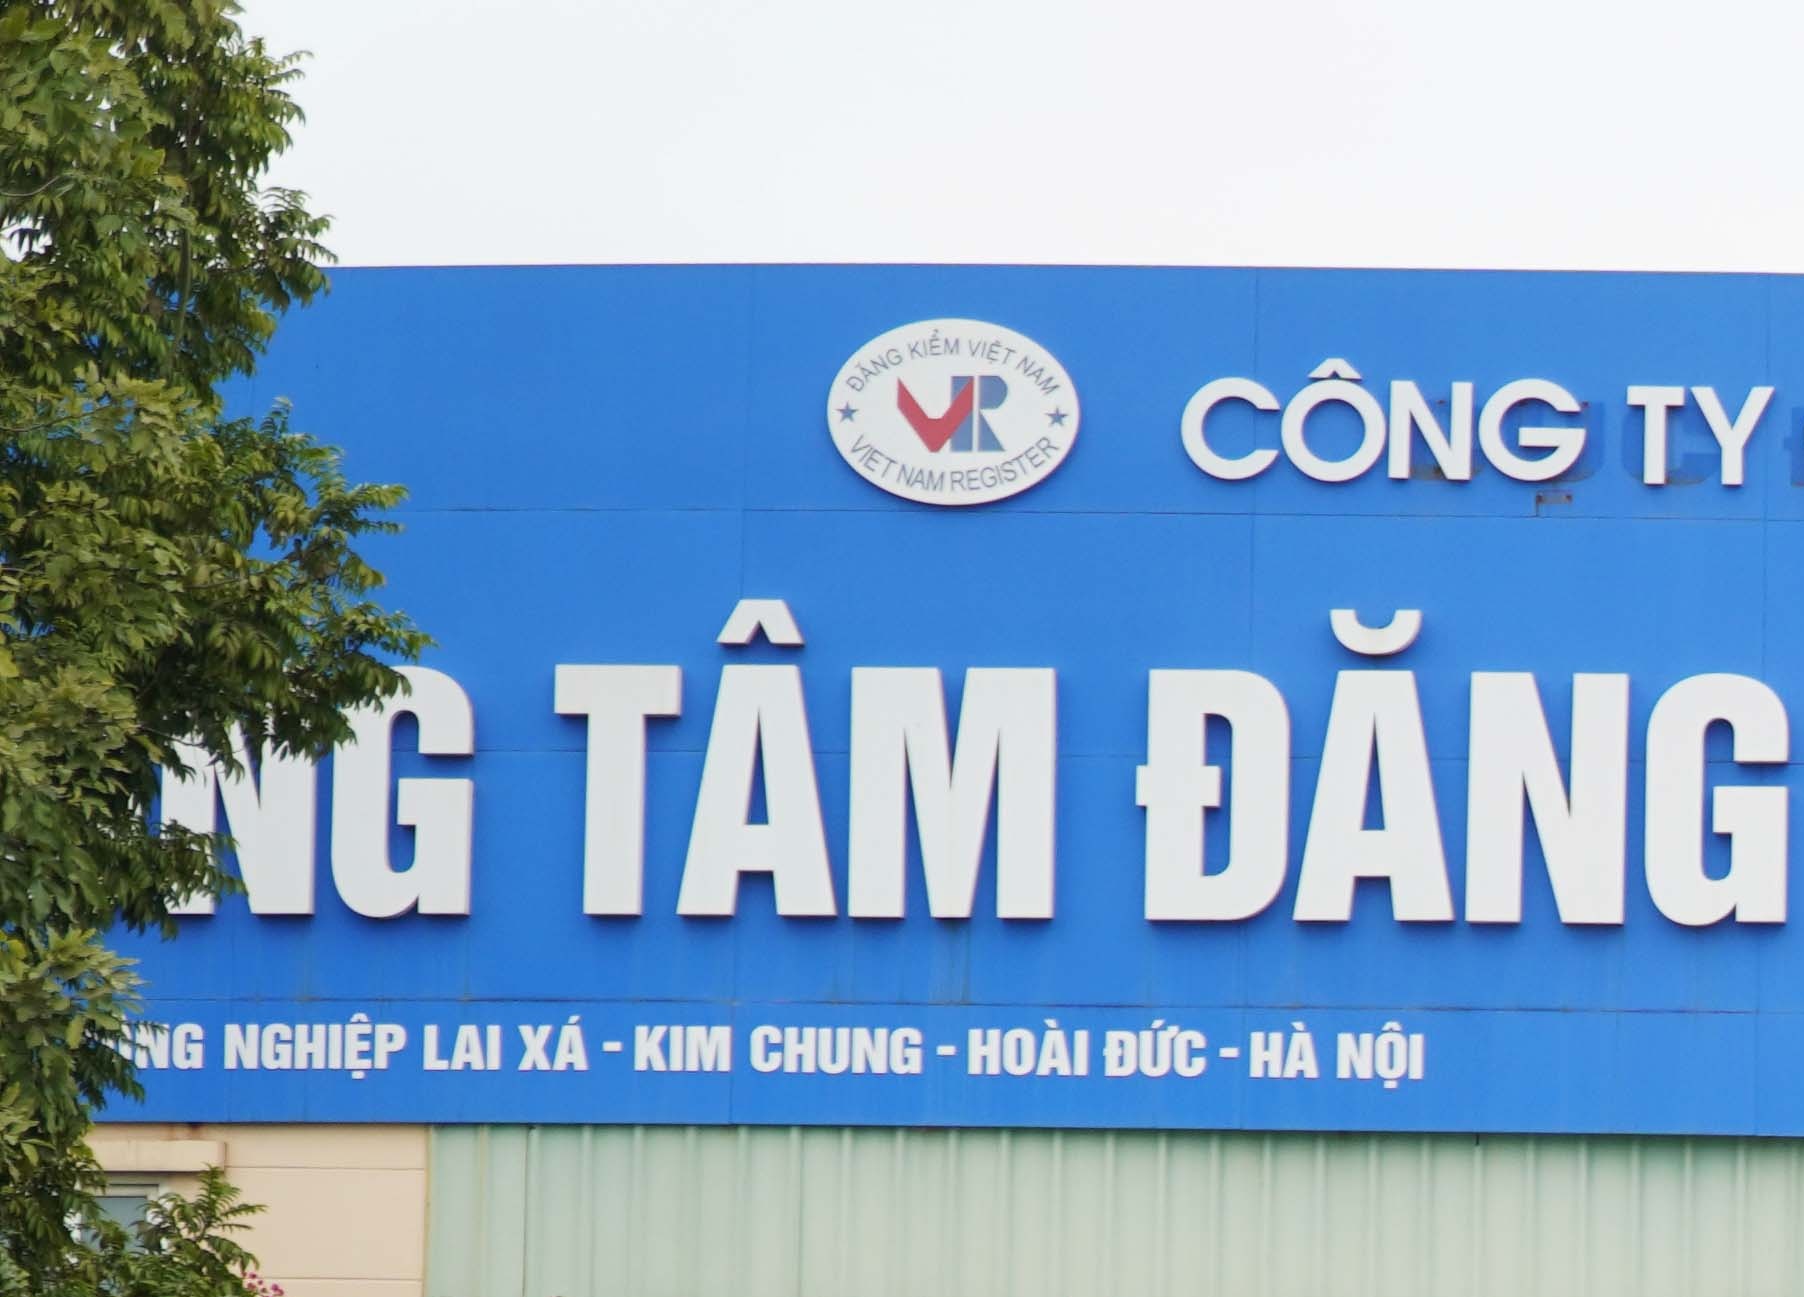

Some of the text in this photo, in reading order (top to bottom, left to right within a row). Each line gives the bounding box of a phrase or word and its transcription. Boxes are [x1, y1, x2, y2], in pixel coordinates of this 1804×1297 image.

[845, 329, 1060, 396] ĐĂNG KIỂM VIỆT NAM
[1182, 358, 1587, 482] CÔNG
[1628, 385, 1775, 485] TY
[850, 434, 1061, 491] VIET NAM REGISTER
[130, 665, 474, 918] NG
[555, 599, 1057, 919] TÂM
[1137, 608, 1790, 926] ĐĂNG
[225, 1013, 407, 1080] NGHIỆP
[424, 1024, 501, 1071] LAI
[520, 1015, 589, 1071] XÁ
[635, 1026, 732, 1072] KIM
[752, 1026, 923, 1075] CHUNG
[969, 1019, 1089, 1076] HOÀI
[1104, 1019, 1207, 1078] ĐỨC
[1251, 1022, 1319, 1079] HÀ
[1338, 1021, 1425, 1089] NỘI
